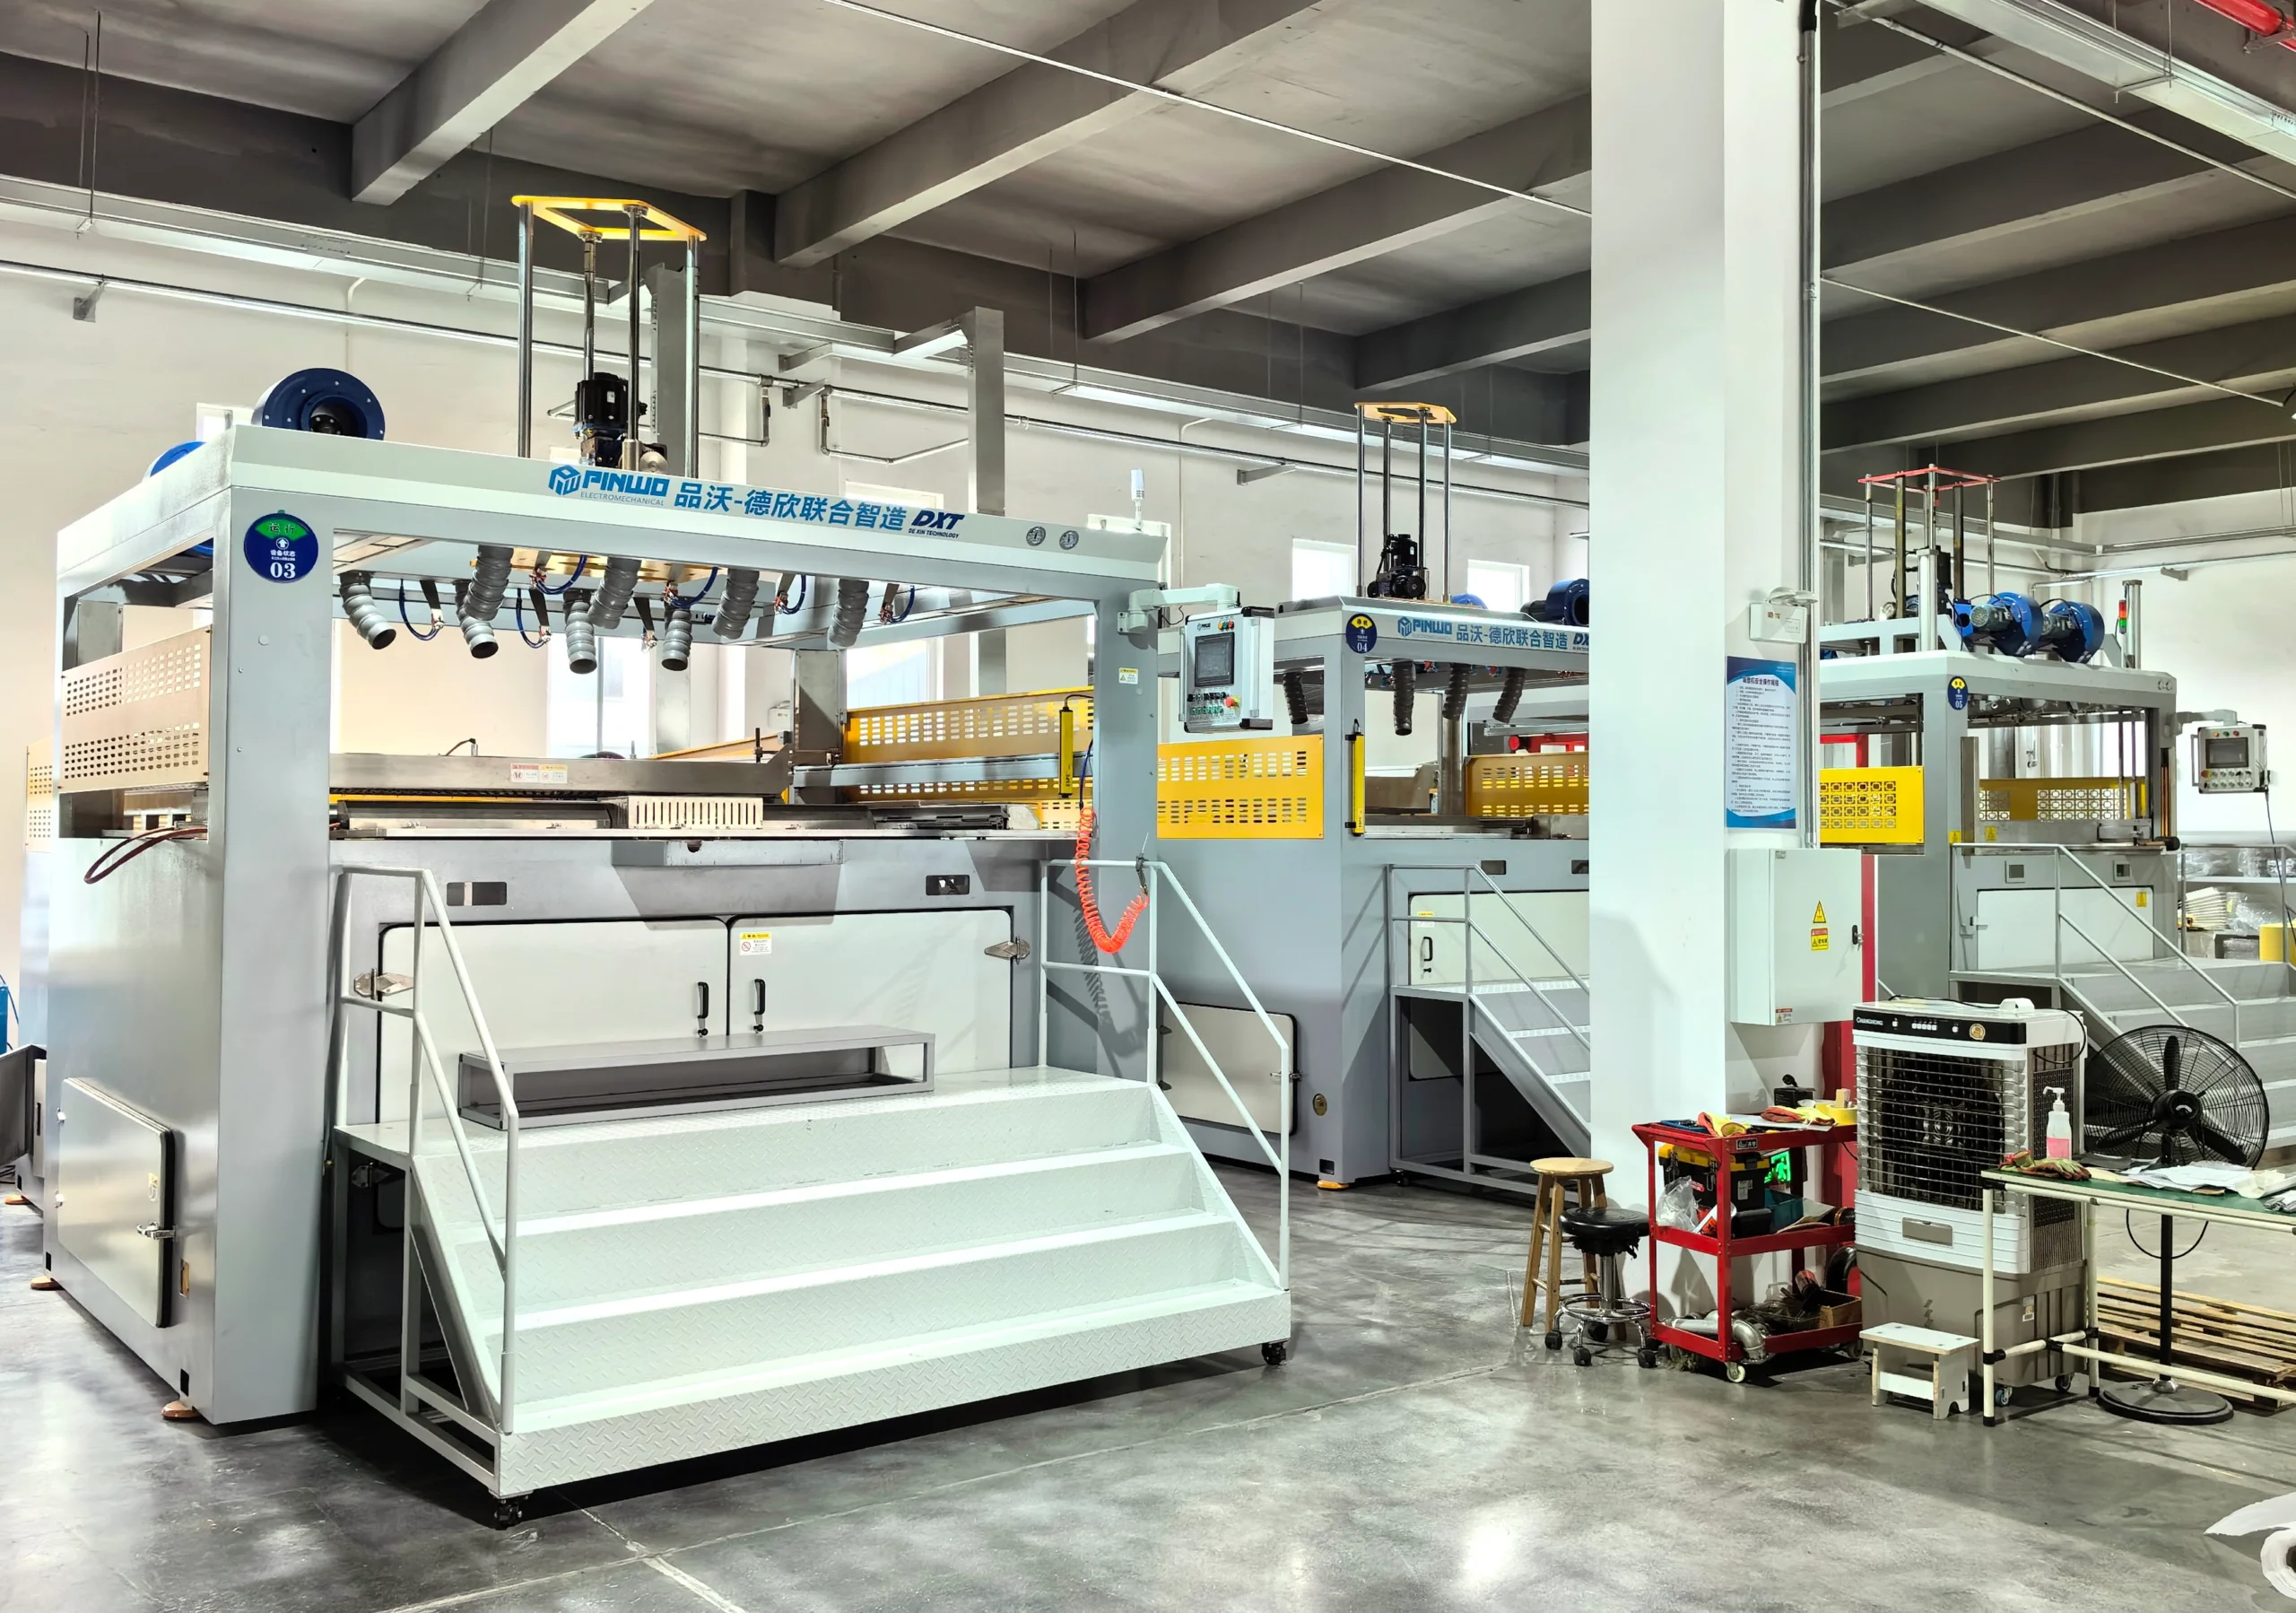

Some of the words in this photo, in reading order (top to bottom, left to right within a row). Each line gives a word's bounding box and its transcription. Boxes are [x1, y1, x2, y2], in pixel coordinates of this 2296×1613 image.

[582, 469, 670, 497] PINWO
[580, 491, 665, 506] ELECTROMECHANICAL
[674, 482, 907, 531] 品沃-德欣联合智造
[911, 510, 965, 530] DXT
[270, 522, 295, 535] 运行
[926, 529, 960, 538] TECHNOLOGY
[270, 549, 296, 557] 设备状态
[270, 562, 296, 579] 03
[1413, 618, 1452, 635] PINWO
[1457, 623, 1568, 650] 品沃-德欣联合智造
[1357, 641, 1368, 652] 04
[1955, 700, 1963, 709] 05
